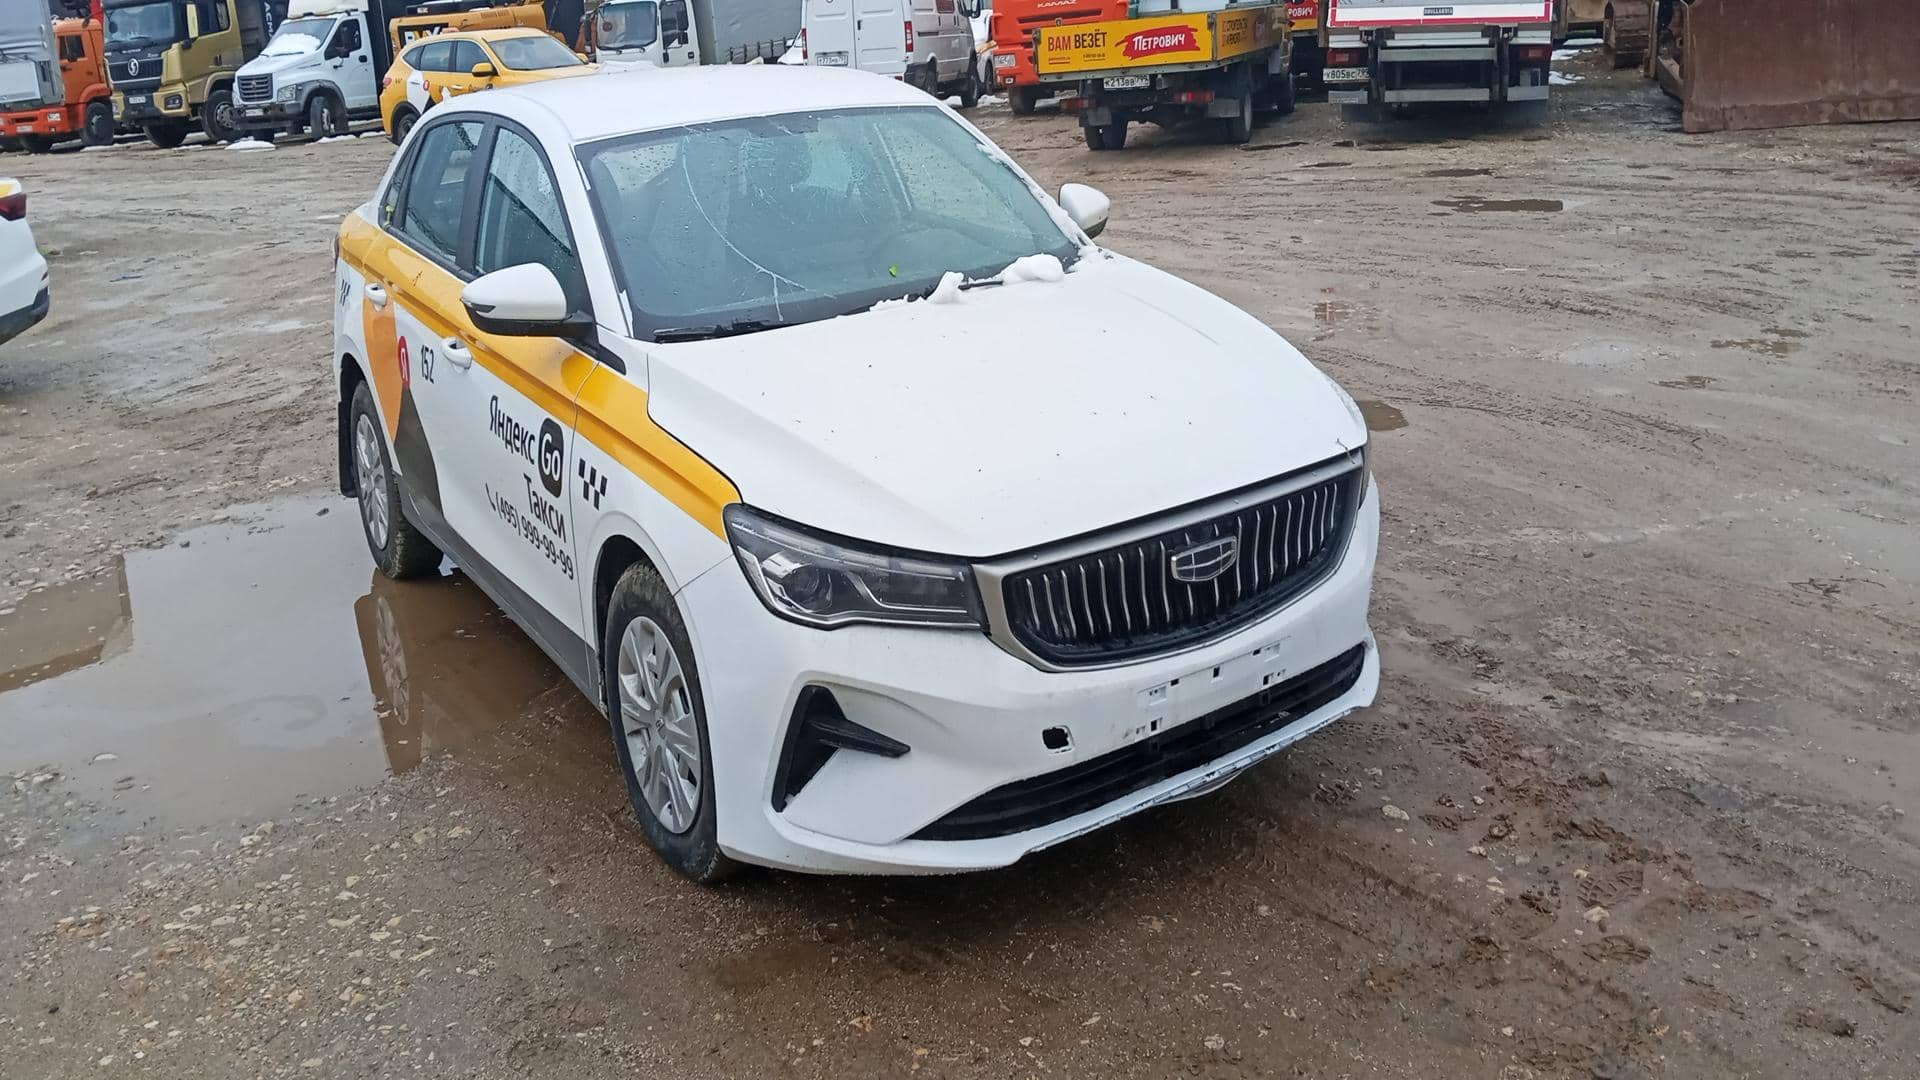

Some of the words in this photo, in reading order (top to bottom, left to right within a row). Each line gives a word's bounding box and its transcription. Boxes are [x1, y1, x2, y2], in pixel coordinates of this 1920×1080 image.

[1048, 35, 1071, 52] ВАМ
[1074, 28, 1107, 49] ВЕЗЁТ
[1132, 33, 1186, 51] ПЕТРОВИЧ
[420, 344, 435, 384] 152
[489, 395, 536, 465] Яндекс
[540, 432, 561, 482] Go
[523, 473, 567, 543] Такси
[495, 491, 521, 536] (495)
[522, 517, 574, 581] 999-99-99
